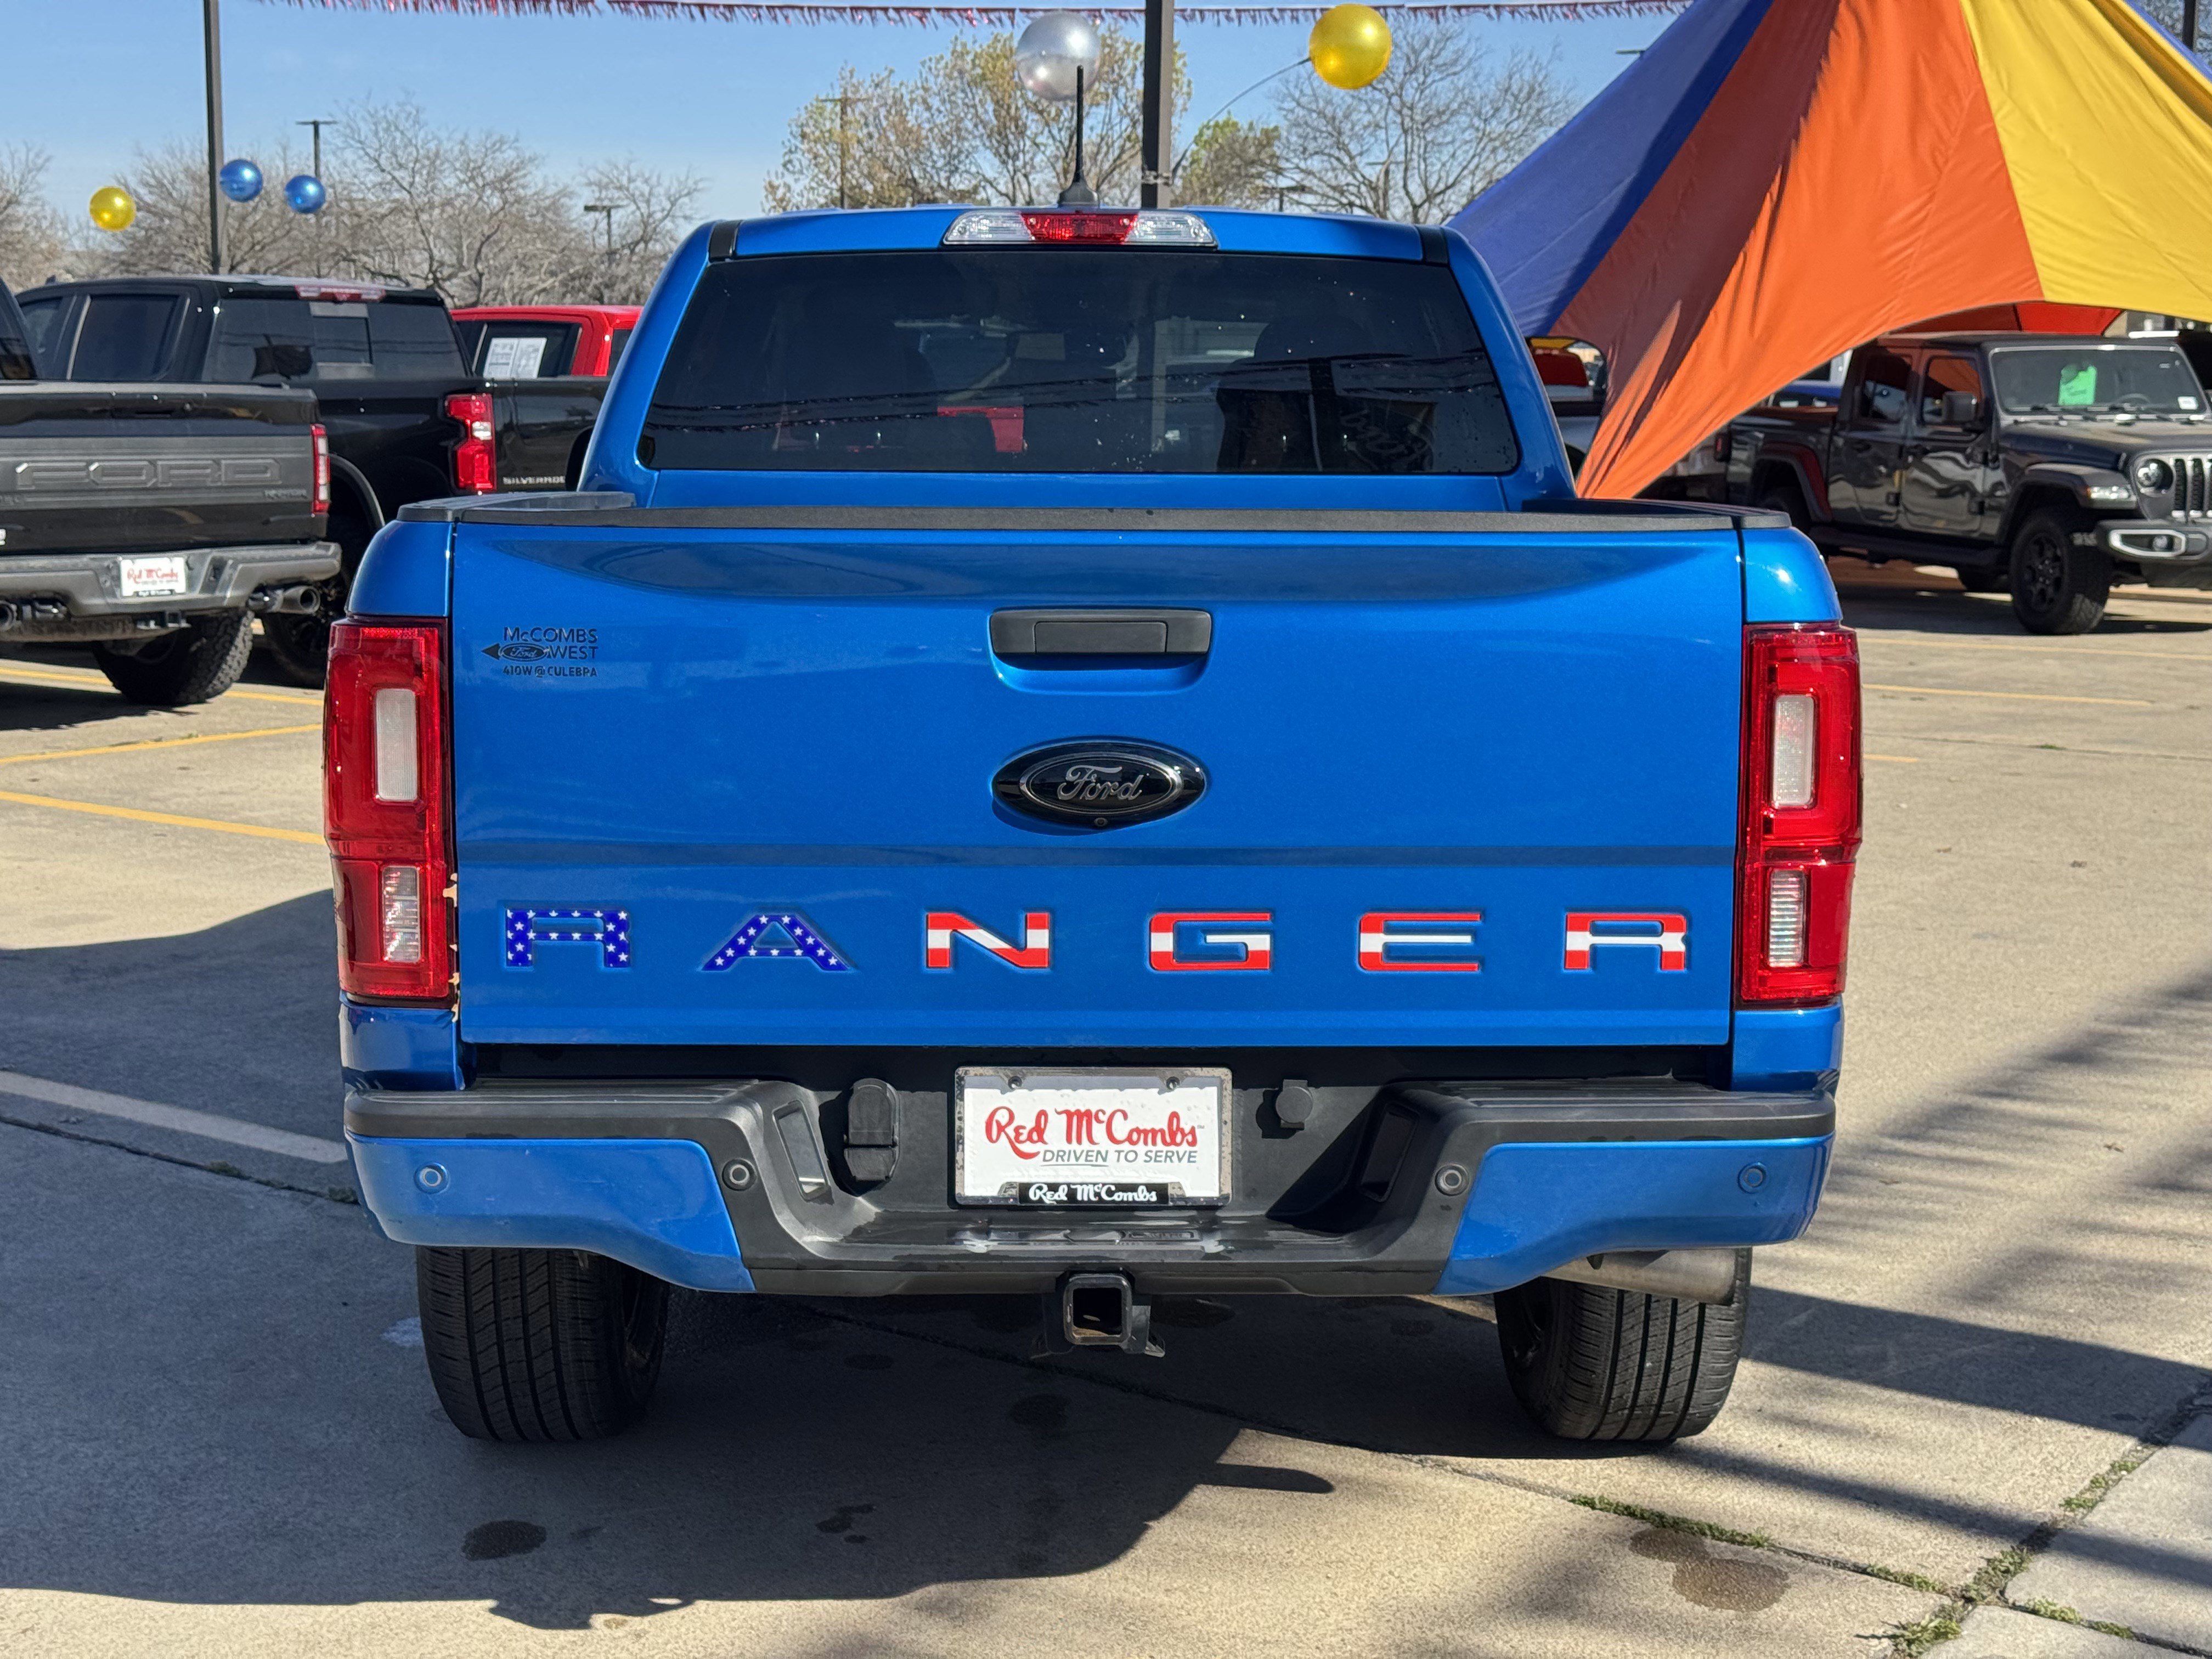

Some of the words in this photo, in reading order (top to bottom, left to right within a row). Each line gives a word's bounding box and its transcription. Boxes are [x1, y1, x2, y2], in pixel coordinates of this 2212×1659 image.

[15, 459, 282, 490] FORD
[503, 627, 598, 644] McCOMBS
[546, 645, 599, 660] WEST
[503, 665, 532, 676] 410W
[534, 665, 545, 678] @
[547, 665, 597, 677] CULEBRA
[1057, 765, 1144, 801] Ford
[505, 907, 1688, 974] RANGER
[985, 1105, 1048, 1160] Red
[1054, 1108, 1198, 1148] McCombs
[1042, 1149, 1109, 1164] DRIVEN
[1114, 1149, 1139, 1163] TO
[1143, 1149, 1198, 1164] SERVE
[1029, 1183, 1068, 1205] Red
[1070, 1183, 1158, 1202] McCombs
